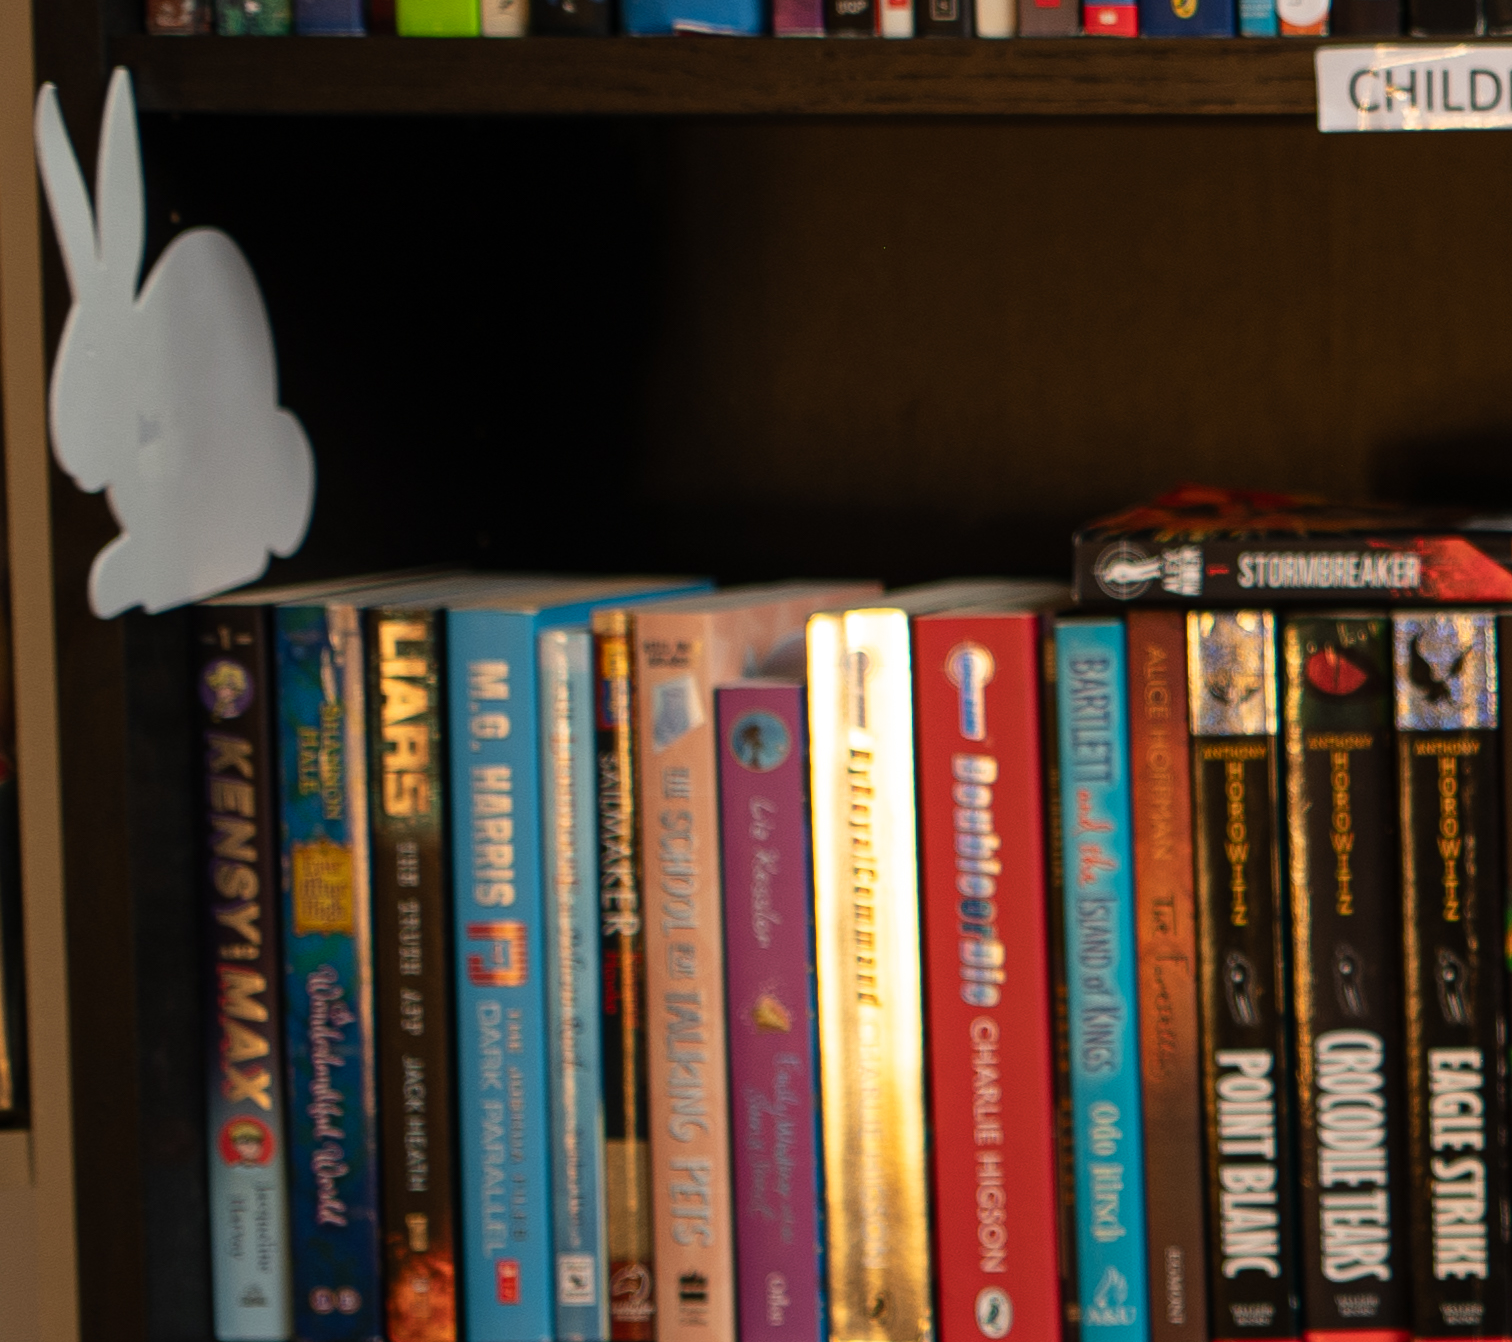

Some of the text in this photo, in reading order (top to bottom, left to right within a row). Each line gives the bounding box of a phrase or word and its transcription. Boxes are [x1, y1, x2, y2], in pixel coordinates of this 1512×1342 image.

[1237, 552, 1420, 587] STORMBREAKER
[1216, 1050, 1275, 1159] POINT
[1429, 1050, 1482, 1146] EAGLE
[1222, 1170, 1279, 1277] BLANC
[1433, 1157, 1486, 1279] STRIKE
